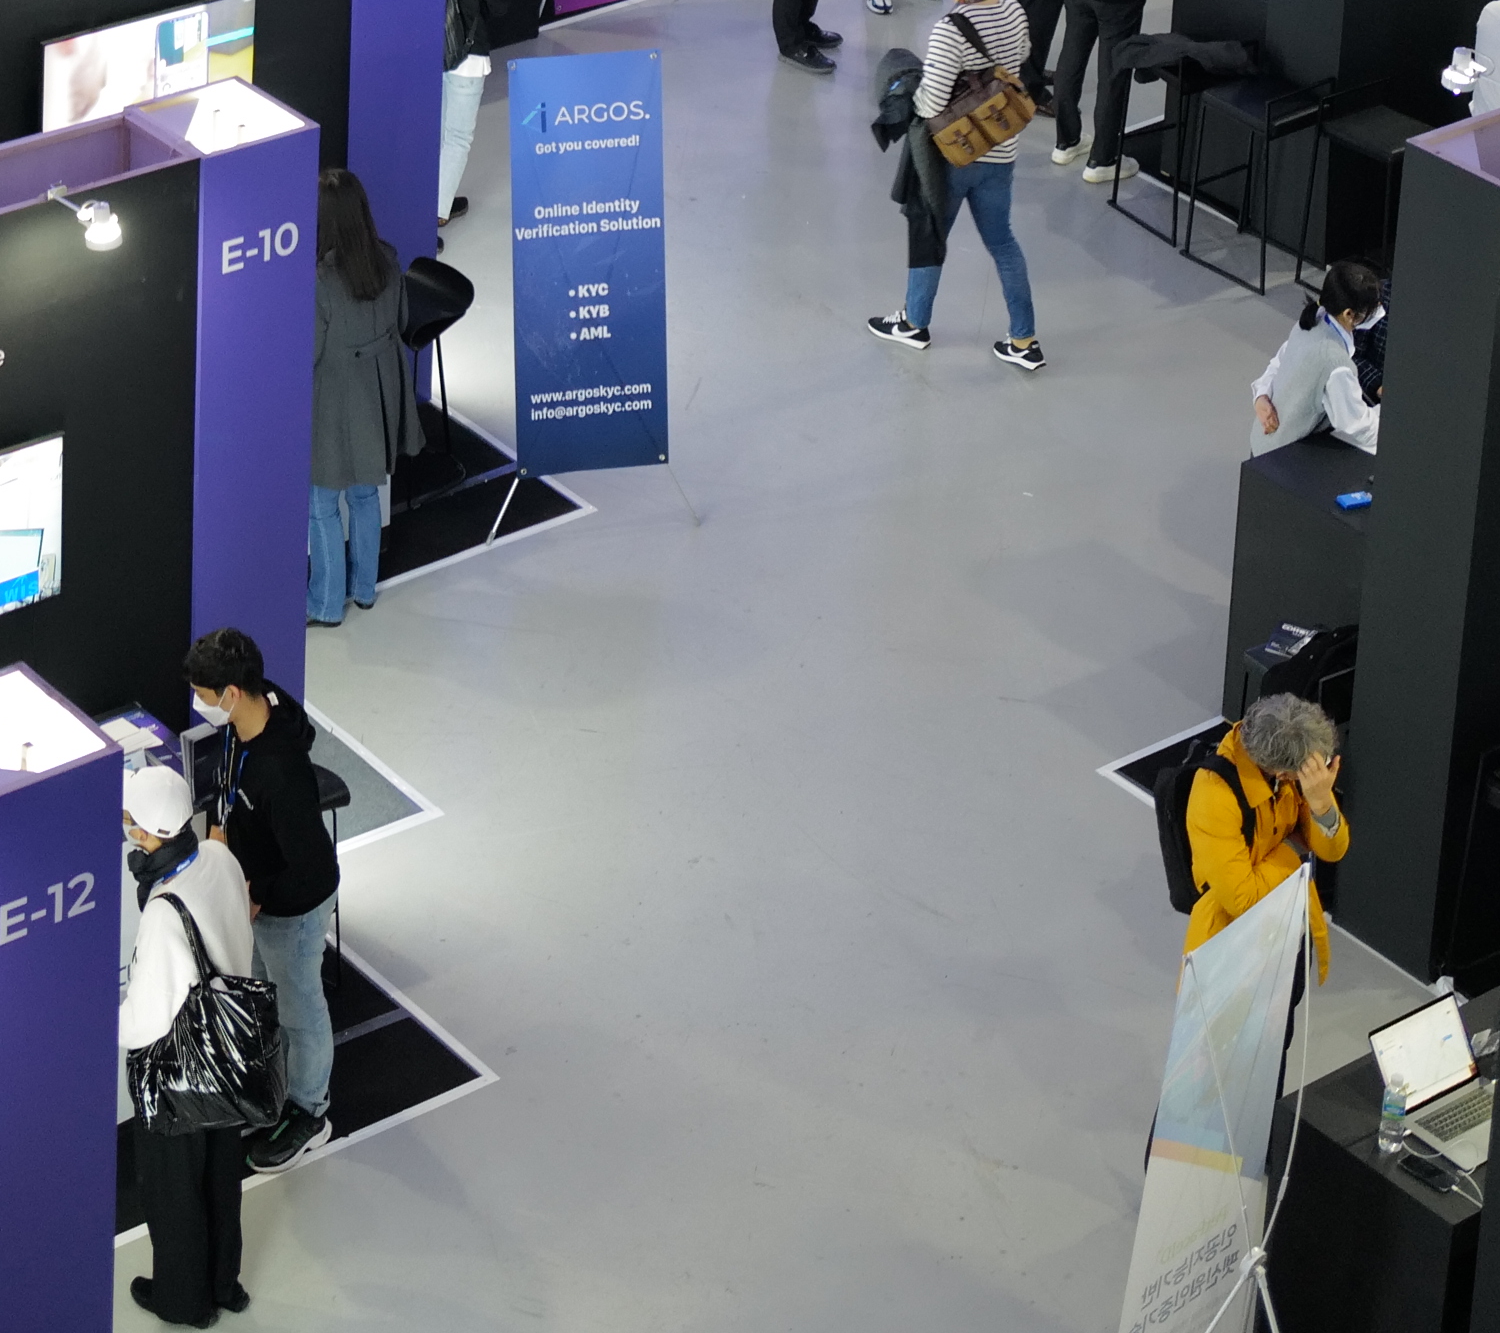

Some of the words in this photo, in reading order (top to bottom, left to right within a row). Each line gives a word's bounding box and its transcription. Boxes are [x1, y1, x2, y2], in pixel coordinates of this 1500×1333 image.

[554, 98, 650, 125] ARGOS.
[535, 138, 561, 155] Got
[565, 138, 589, 156] you
[591, 134, 641, 153] covered!
[534, 202, 578, 220] Online
[583, 197, 641, 221] Identity
[514, 219, 596, 242] Verification
[600, 214, 662, 235] Solution
[221, 222, 300, 275] E-10
[577, 282, 609, 299] KYC
[578, 303, 610, 320] KYB
[579, 325, 612, 341] AML
[531, 381, 652, 406] www.argoskyc.com
[531, 397, 652, 423] info@argoskyc.com
[0, 871, 96, 946] E-12
